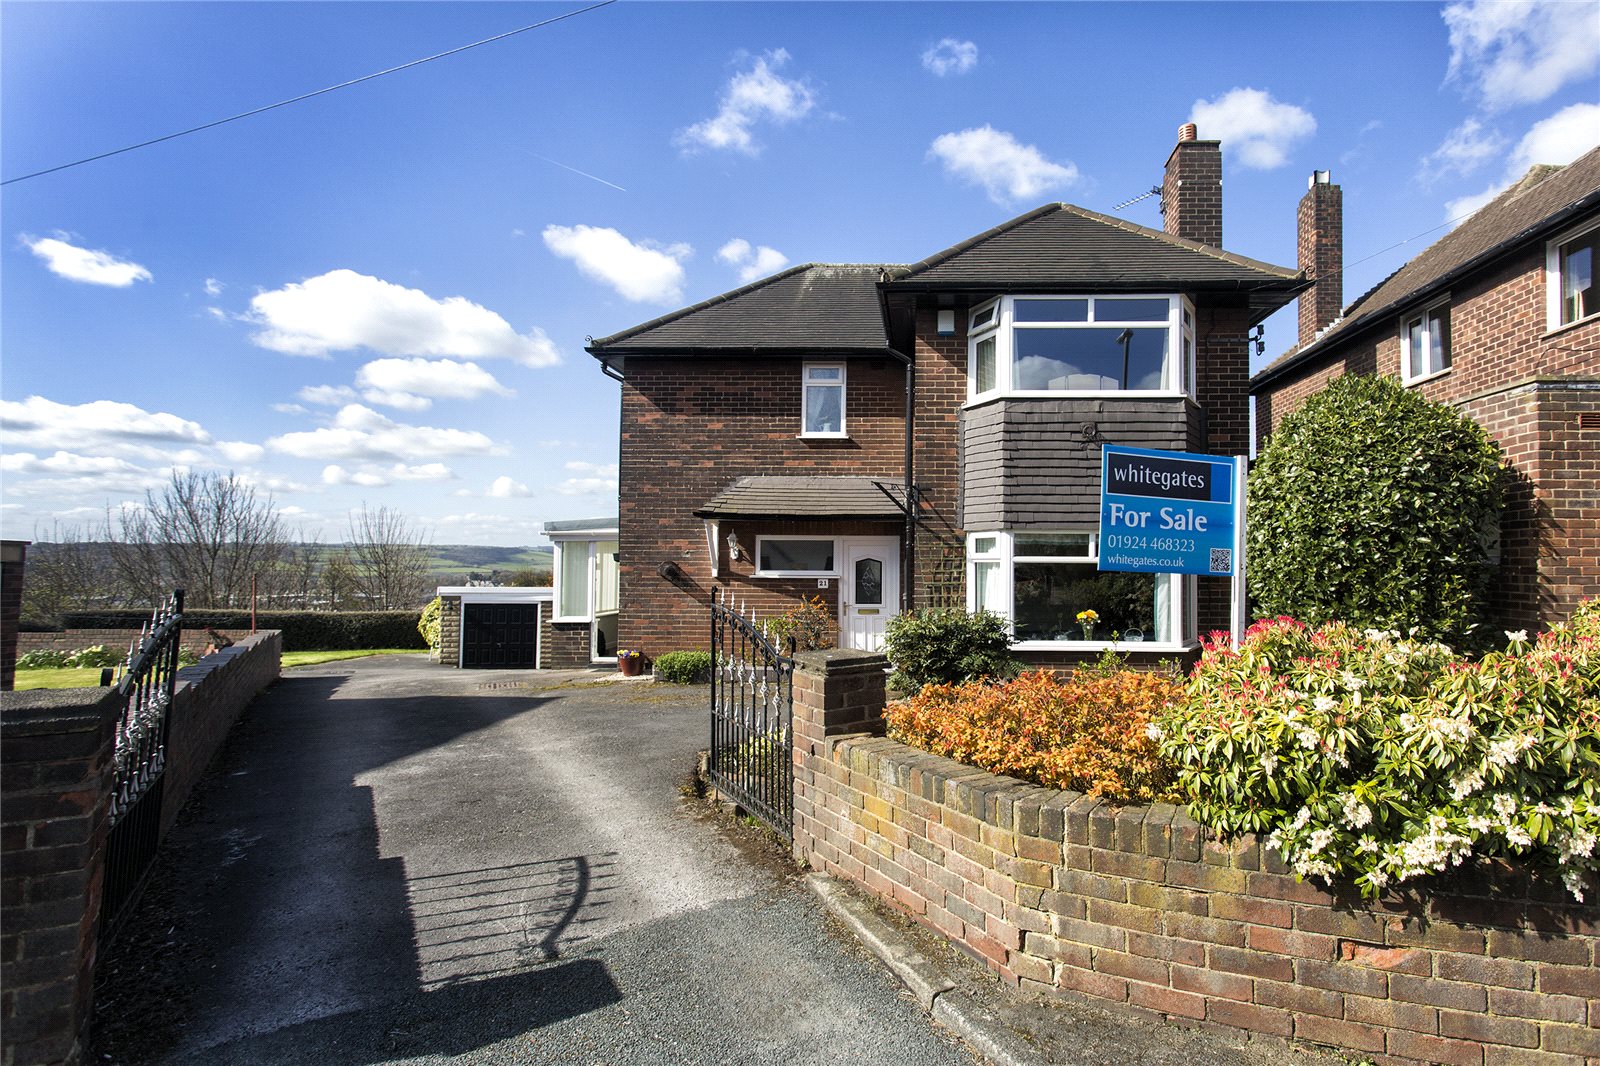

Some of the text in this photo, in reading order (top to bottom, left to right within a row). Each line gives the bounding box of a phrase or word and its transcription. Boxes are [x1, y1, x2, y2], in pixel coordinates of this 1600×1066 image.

[1114, 464, 1205, 490] whitegates
[1109, 503, 1208, 532] For Sale
[1108, 534, 1195, 552] 01924 468323
[1107, 554, 1184, 568] whitegates.co.uk
